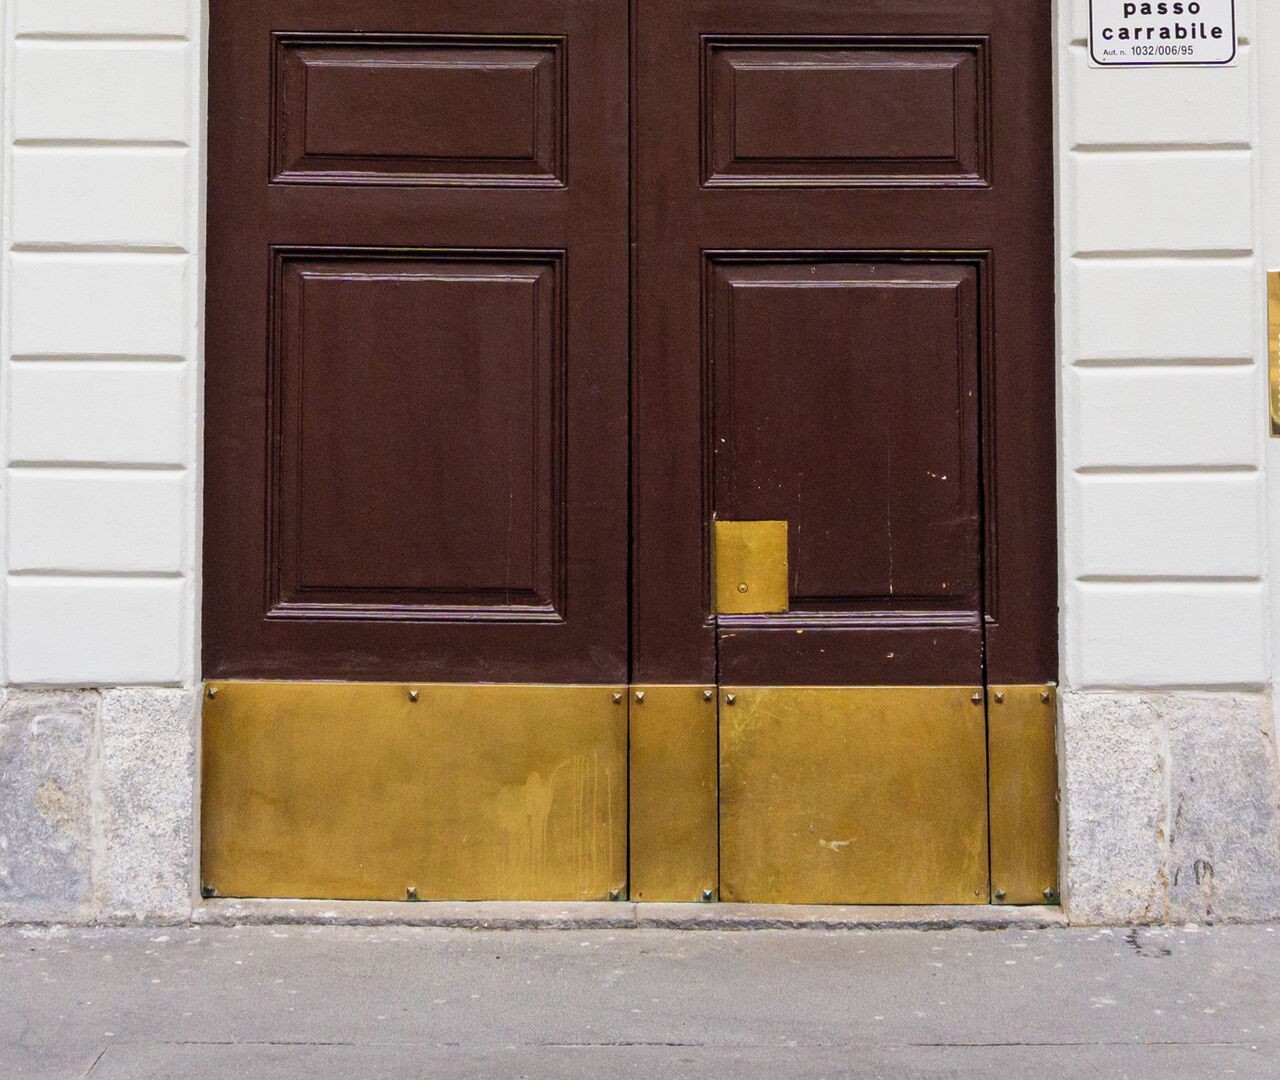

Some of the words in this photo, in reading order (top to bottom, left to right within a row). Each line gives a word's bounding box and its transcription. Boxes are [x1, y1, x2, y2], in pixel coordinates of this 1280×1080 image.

[1123, 1, 1200, 18] passo
[1101, 22, 1223, 40] carrabile
[1130, 45, 1194, 56] 1032/006/95
